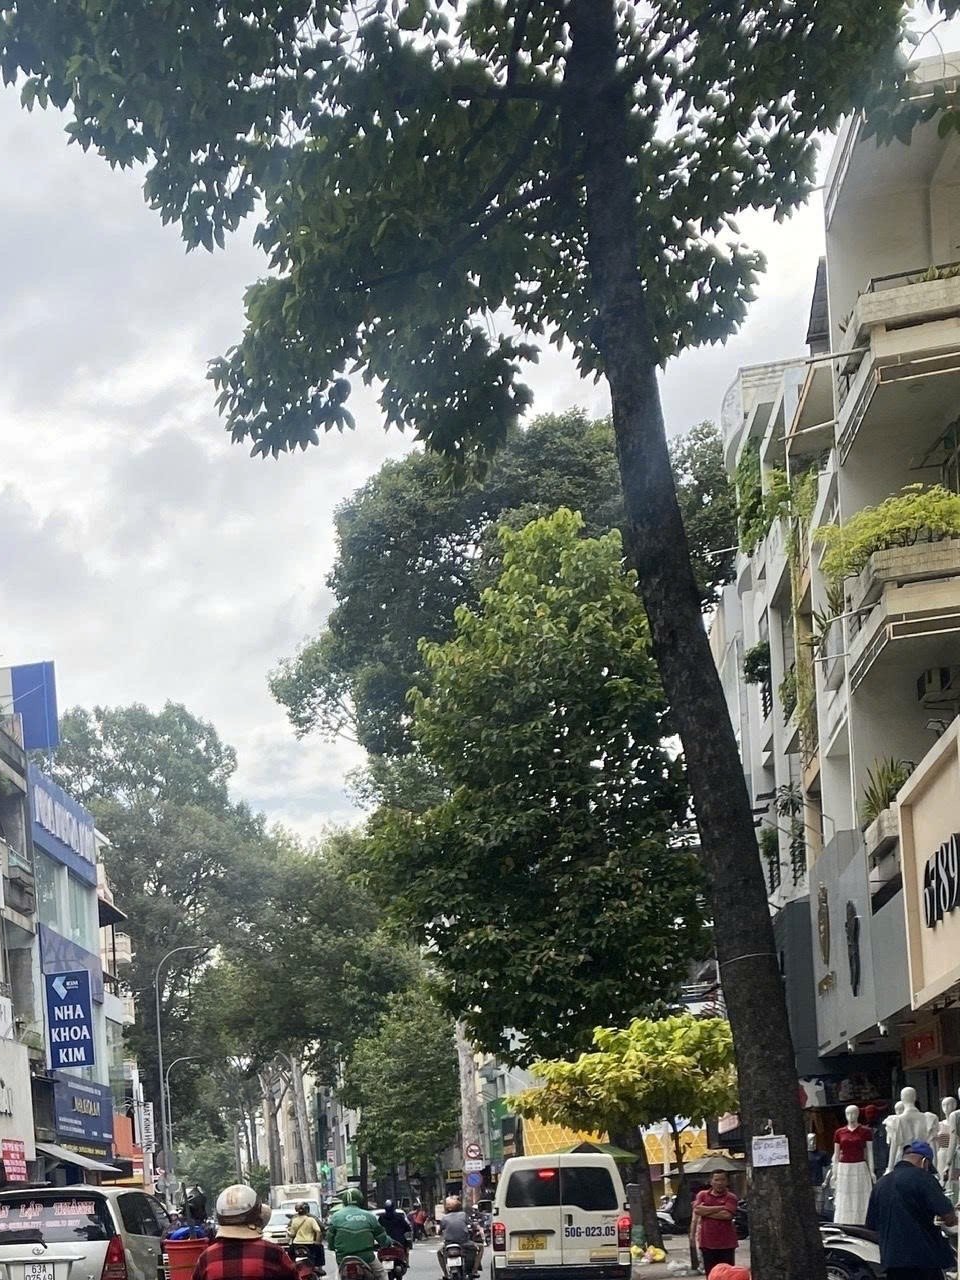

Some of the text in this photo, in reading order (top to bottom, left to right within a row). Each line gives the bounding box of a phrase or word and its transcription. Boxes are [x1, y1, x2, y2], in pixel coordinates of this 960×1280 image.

[54, 1004, 85, 1022] NHA
[51, 1025, 90, 1043] KHOA
[59, 1047, 86, 1064] KIM
[345, 1214, 367, 1222] Grab
[565, 1226, 616, 1237] 50G-023.05
[31, 1264, 47, 1274] 63A
